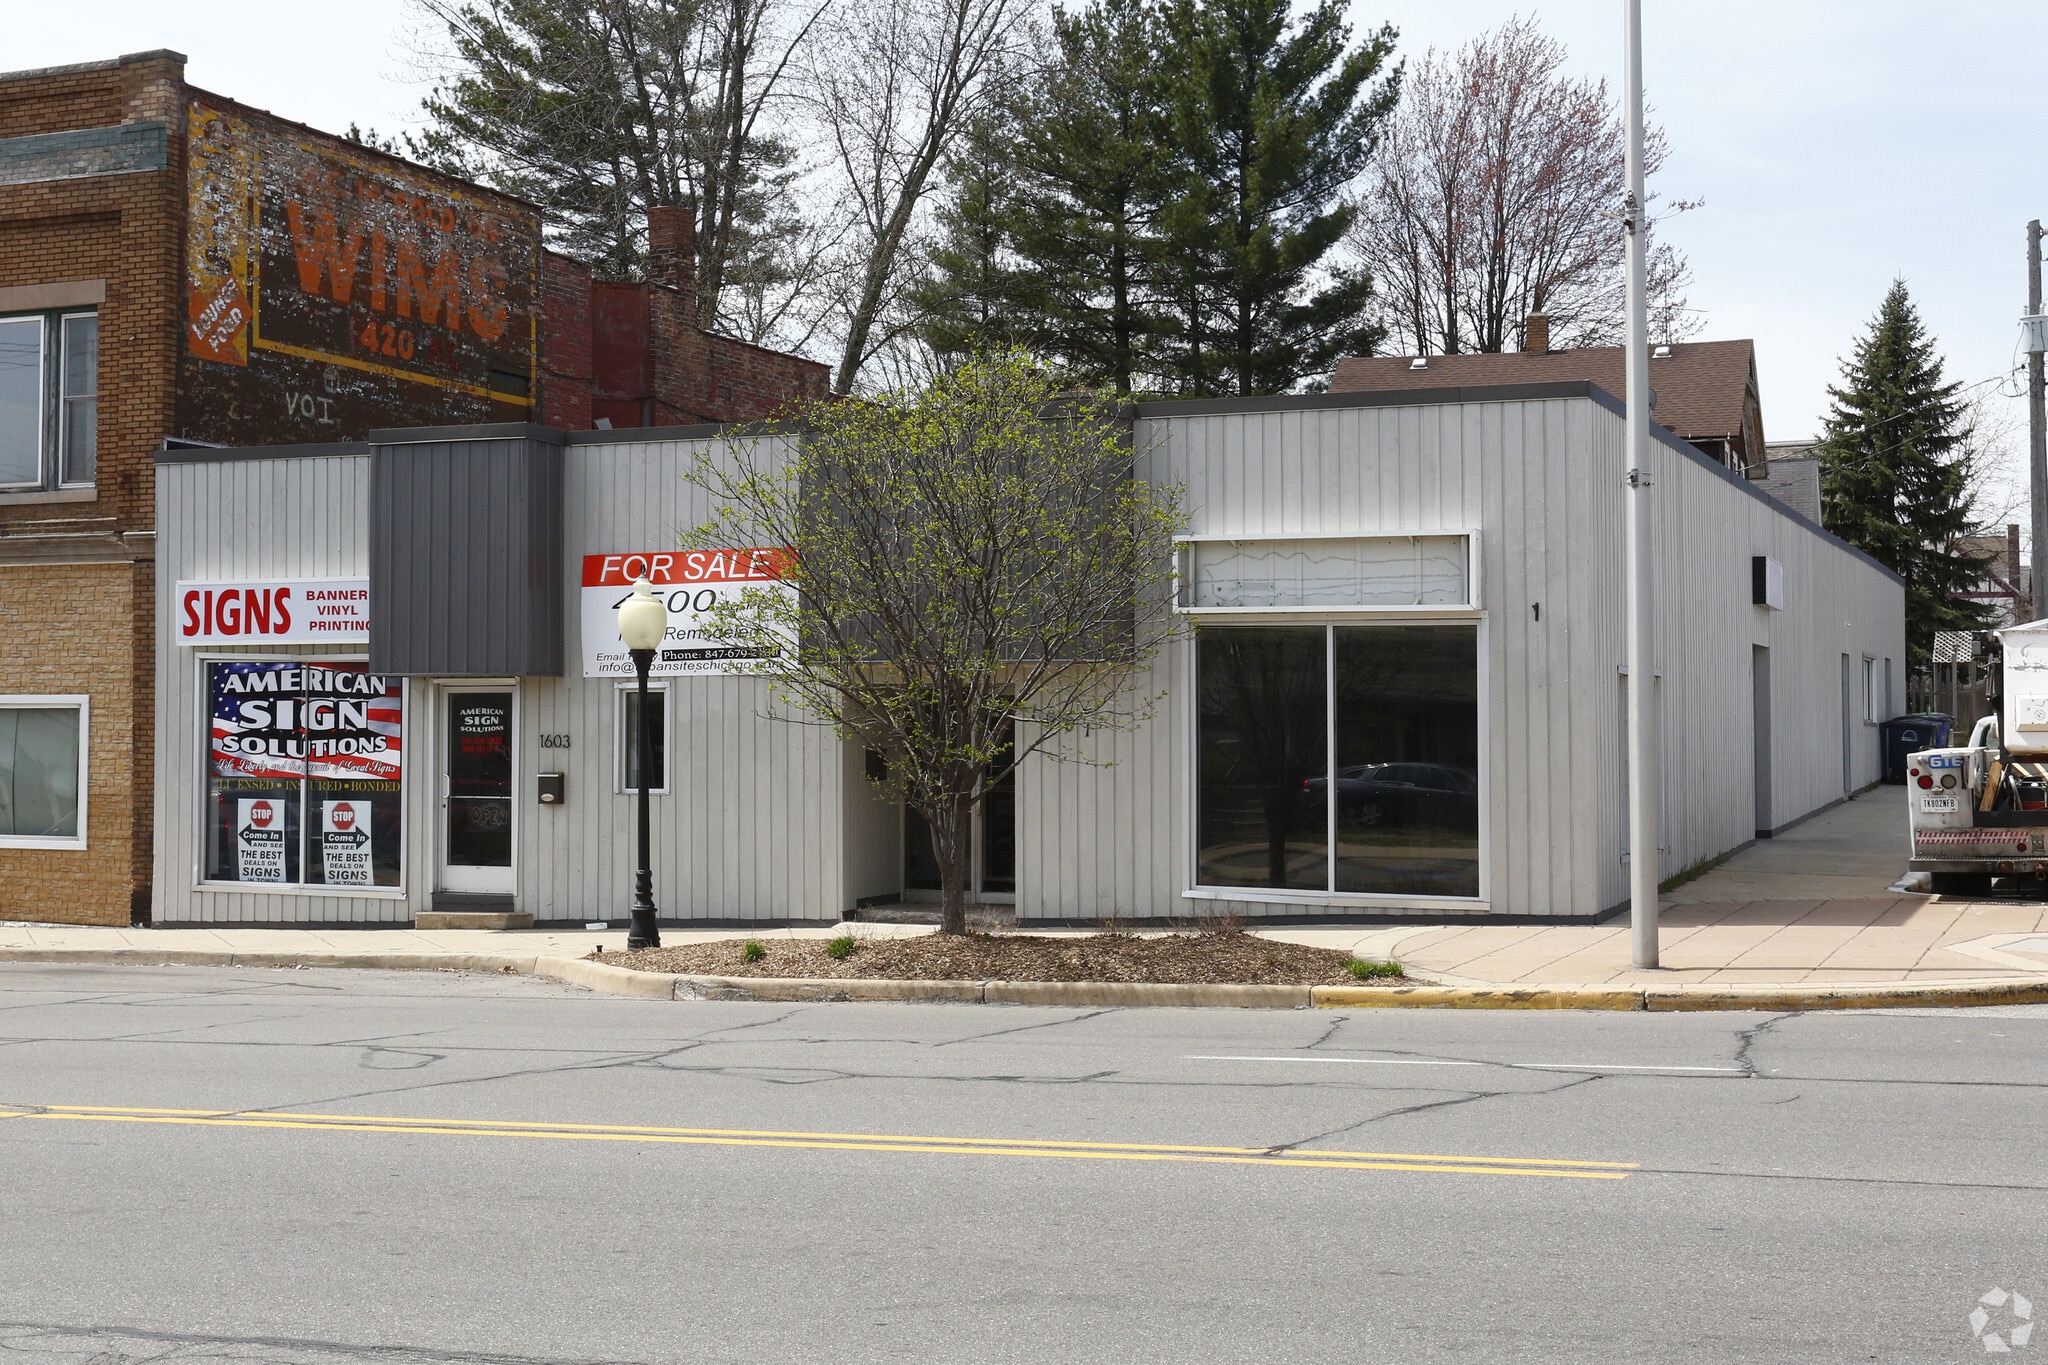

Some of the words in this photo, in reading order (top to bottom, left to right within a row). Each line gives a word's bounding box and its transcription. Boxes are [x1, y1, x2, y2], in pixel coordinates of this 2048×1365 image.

[600, 554, 674, 582] FOR
[684, 549, 773, 580] SALE
[182, 587, 292, 637] SIGNS
[317, 604, 358, 616] VINYL
[596, 652, 625, 661] Email
[663, 650, 702, 660] Phone:
[705, 647, 779, 659] 847-679-2
[222, 668, 386, 695] AMERICAN
[238, 699, 369, 731] SIGN
[459, 707, 504, 716] AMERICAN
[464, 716, 499, 726] SIGN
[460, 725, 504, 733] SOLUTIONS
[221, 735, 388, 758] SOLUTIONS
[539, 734, 571, 749] 1603
[1930, 756, 1962, 767] GTE
[219, 779, 274, 791] LIENSED
[351, 780, 401, 792] BONDED
[252, 808, 272, 820] STOP
[333, 811, 354, 822] STOP
[243, 831, 268, 840] Come
[270, 831, 279, 840] In
[328, 833, 354, 842] Come
[356, 834, 366, 842] In
[241, 850, 257, 859] THE
[260, 851, 283, 860] BEST
[326, 853, 343, 862] THE
[346, 853, 370, 862] BEST
[242, 867, 281, 878] SIGNS
[328, 870, 368, 881] SIGNS
